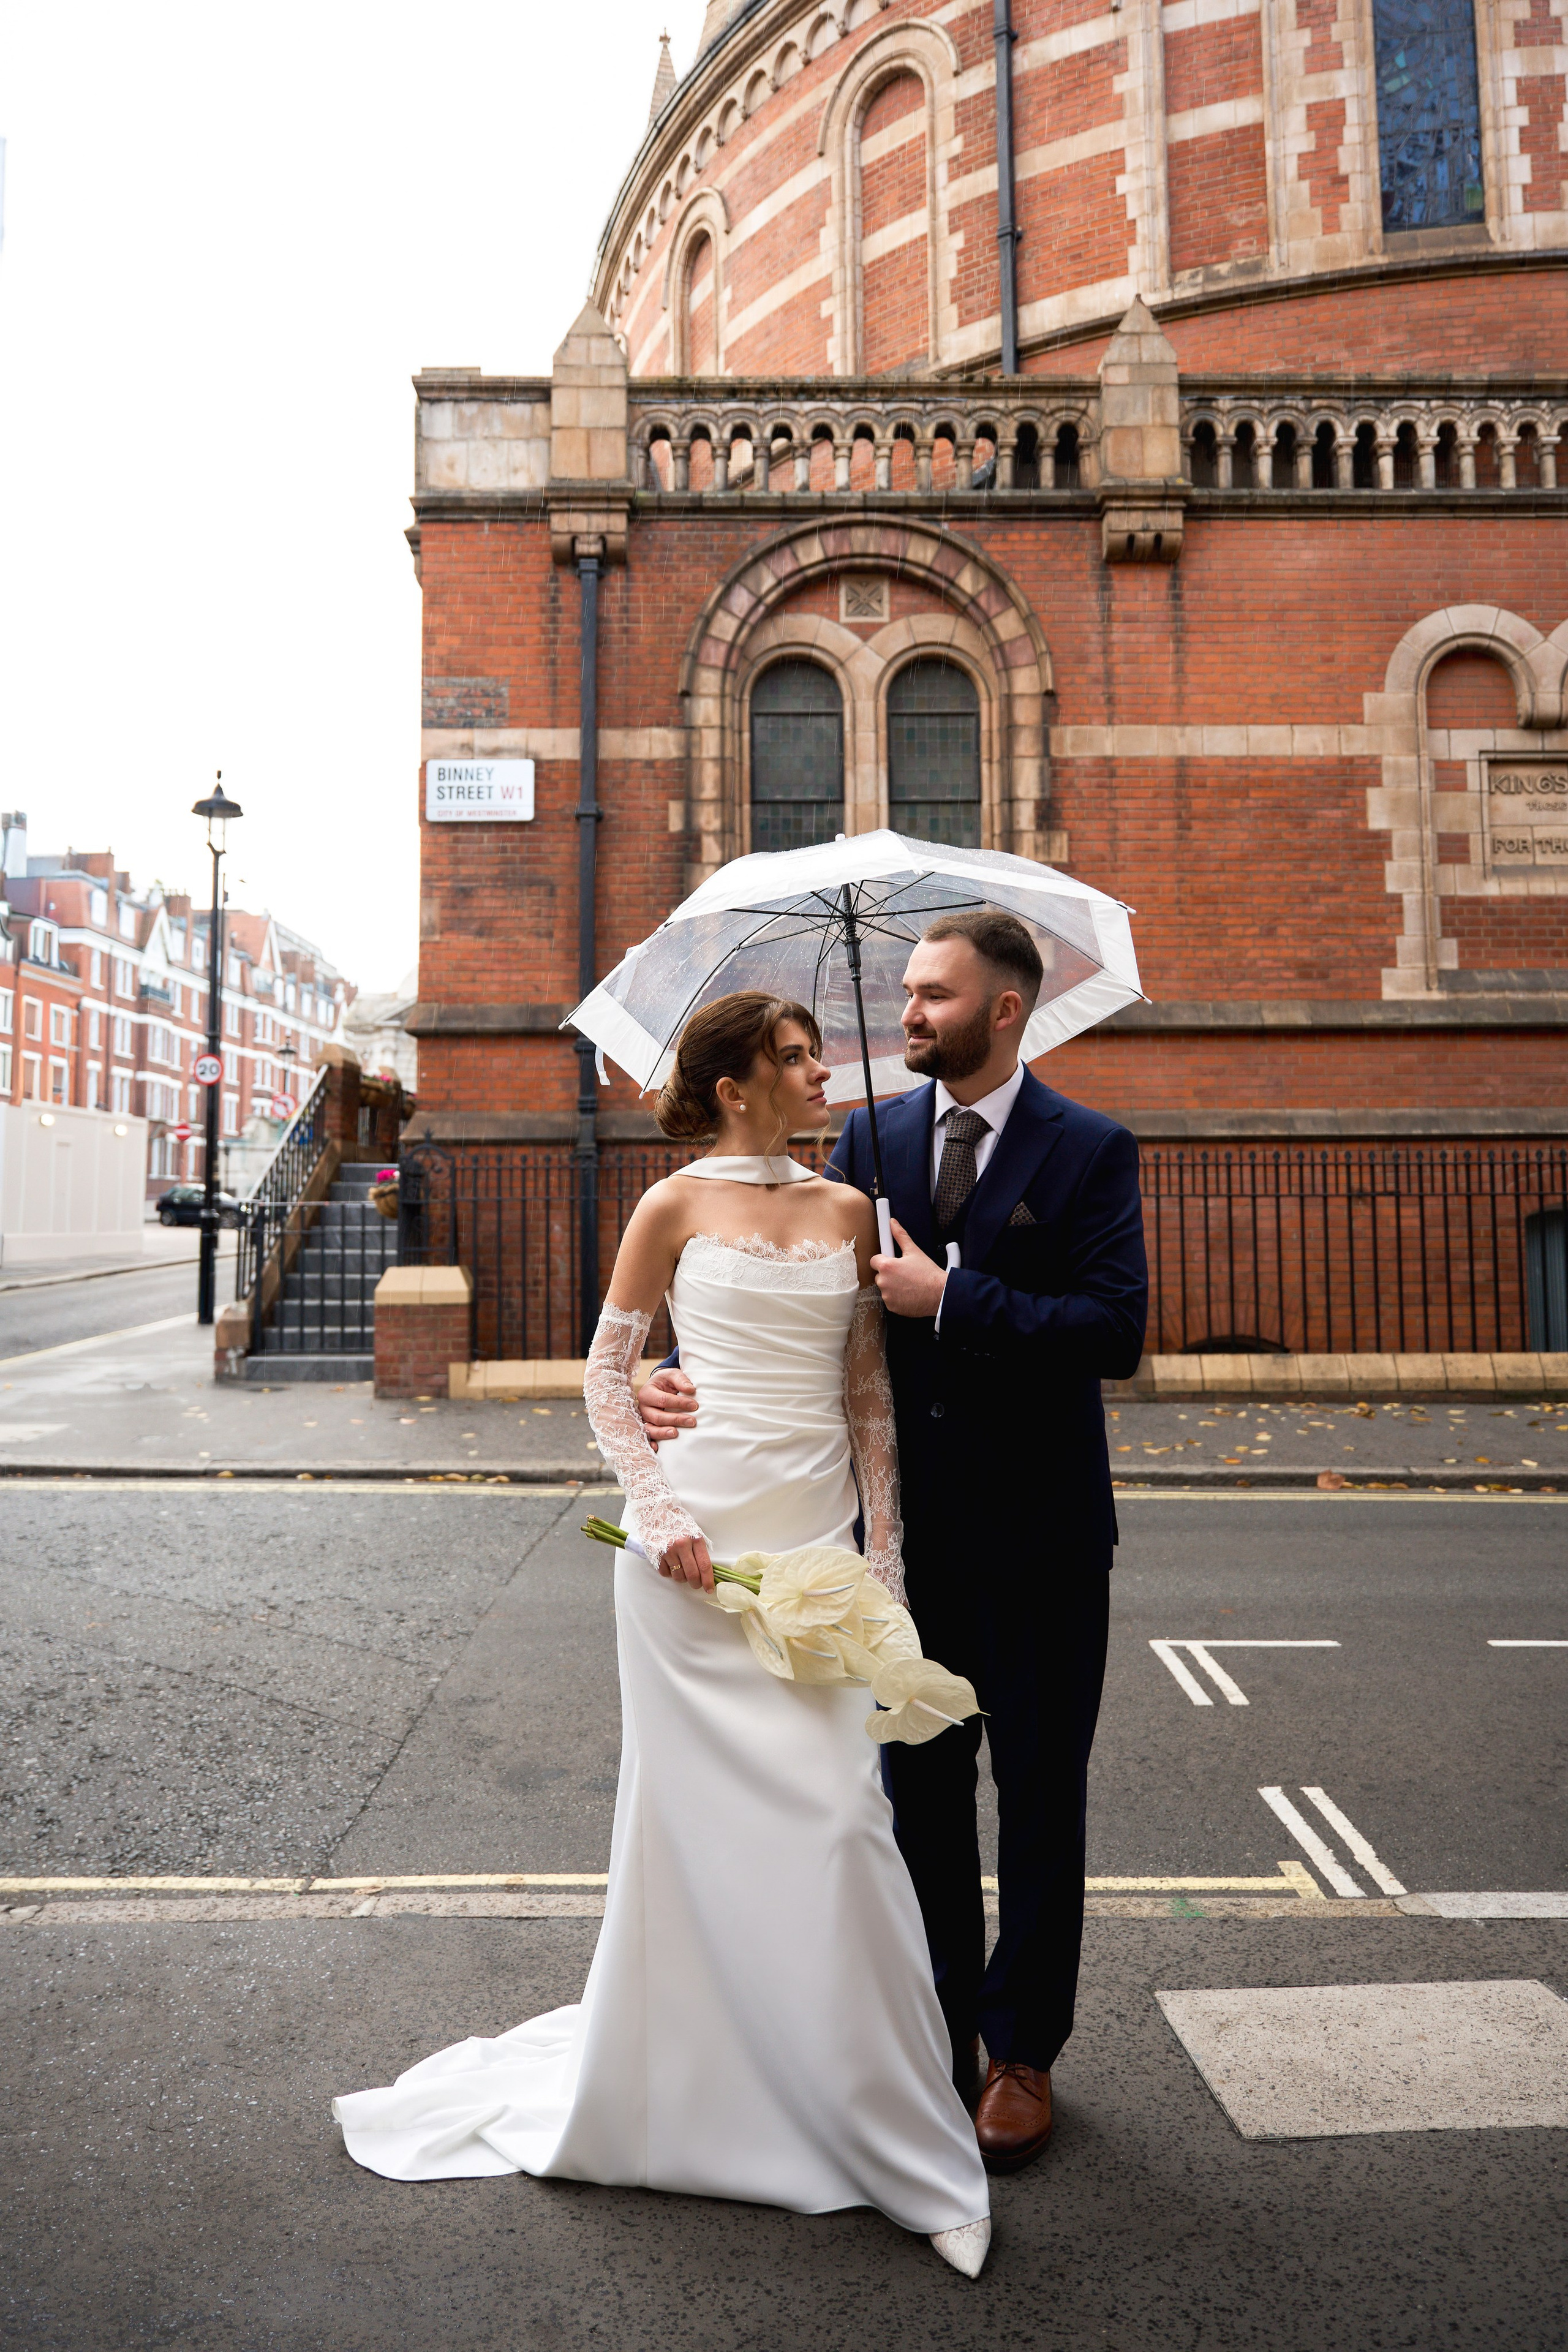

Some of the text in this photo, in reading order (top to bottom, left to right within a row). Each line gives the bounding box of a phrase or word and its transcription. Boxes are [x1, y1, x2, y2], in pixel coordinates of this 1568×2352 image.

[437, 767, 494, 781] BINNEY
[437, 786, 522, 799] STREET W1
[1493, 837, 1531, 854] FOR
[198, 1063, 219, 1075] 20
